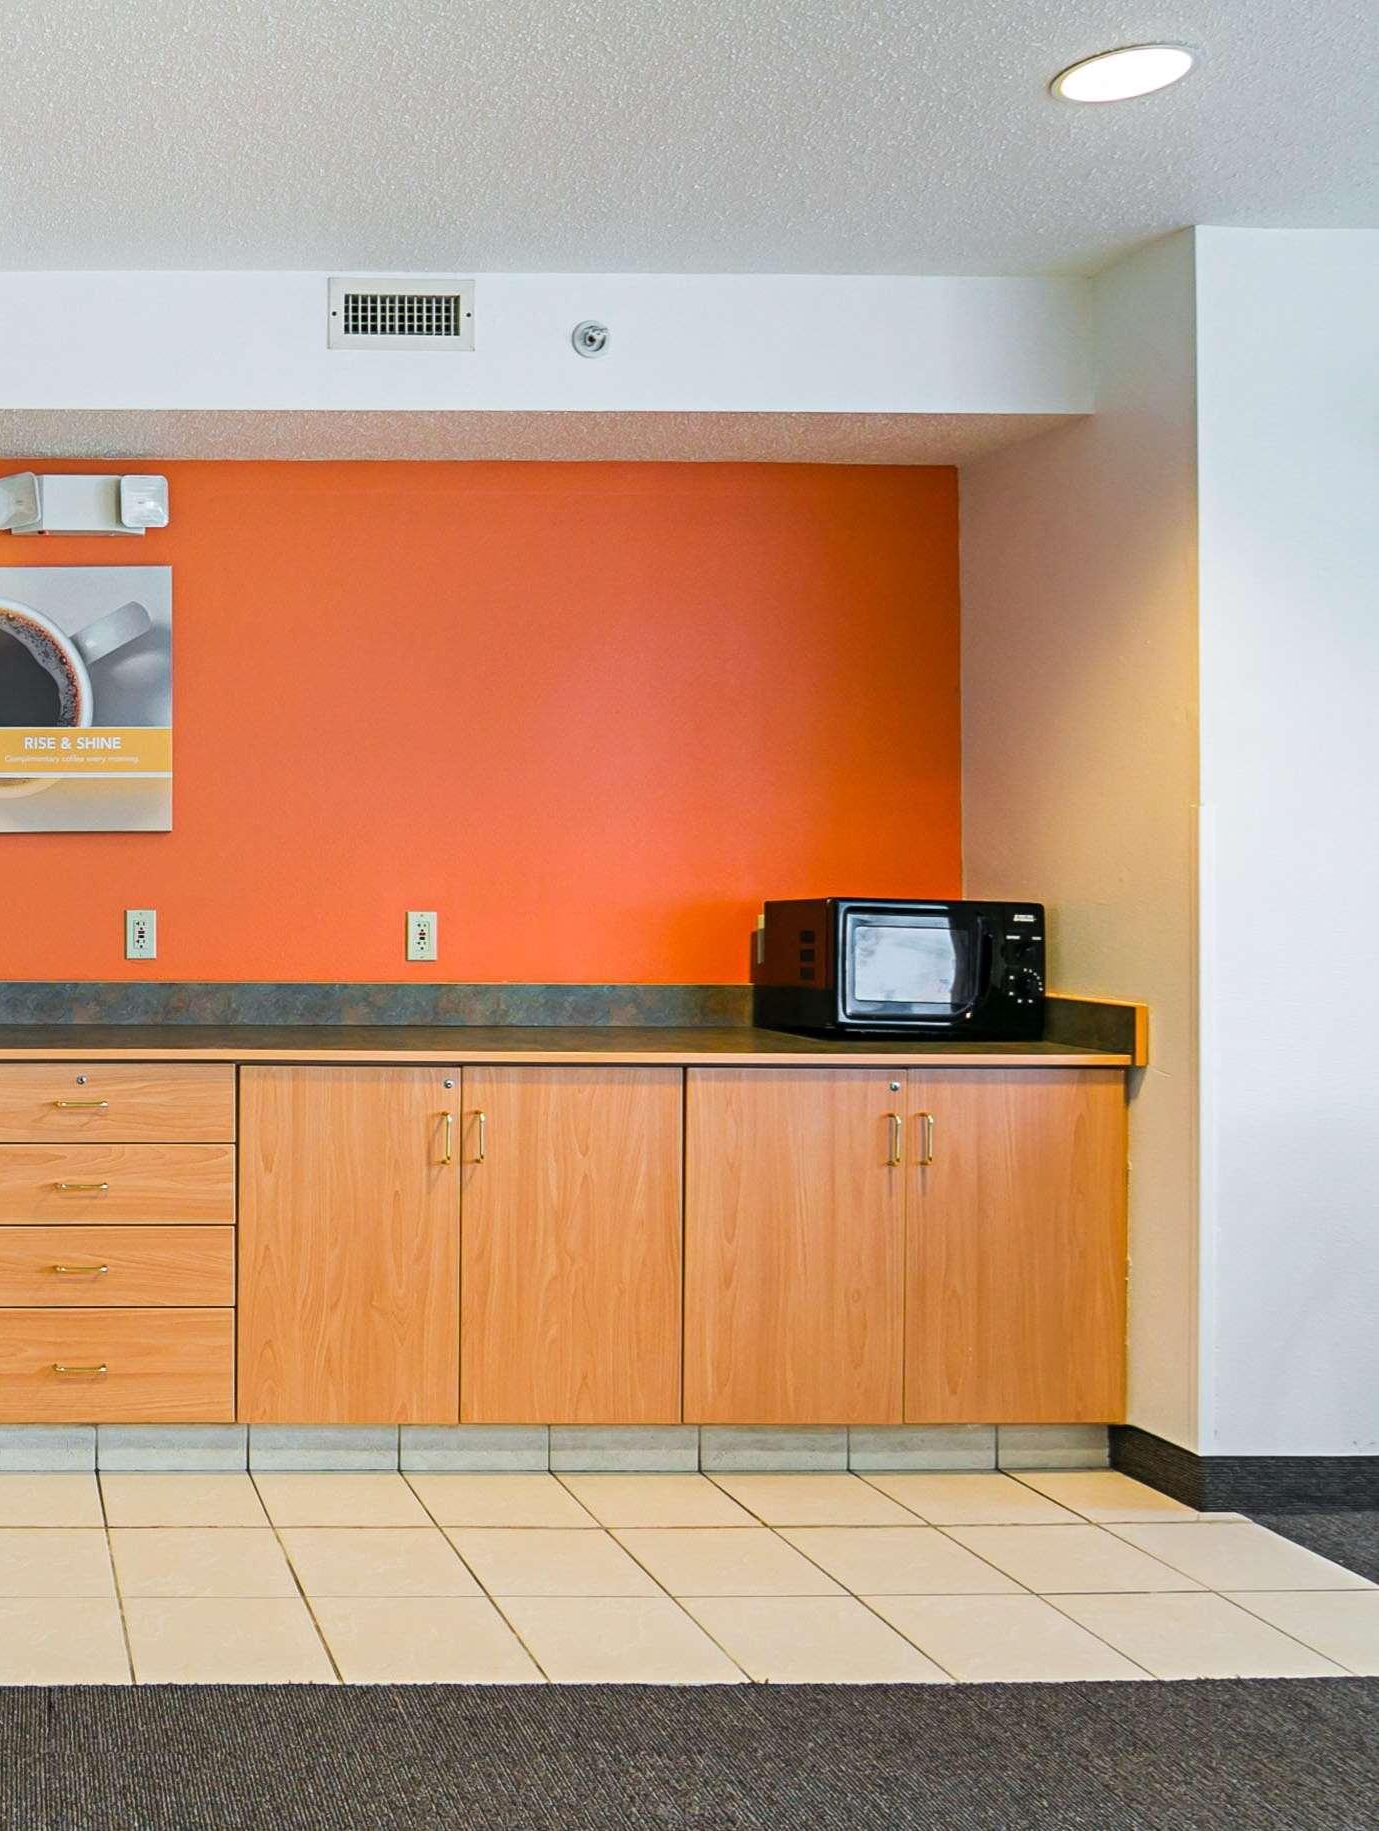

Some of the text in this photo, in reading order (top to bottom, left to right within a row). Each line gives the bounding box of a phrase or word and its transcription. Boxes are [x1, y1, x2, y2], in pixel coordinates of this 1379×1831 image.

[24, 736, 122, 749] RISE & SHINE
[4, 754, 60, 764] Complimentary
[62, 754, 85, 763] coffee
[86, 755, 106, 764] every
